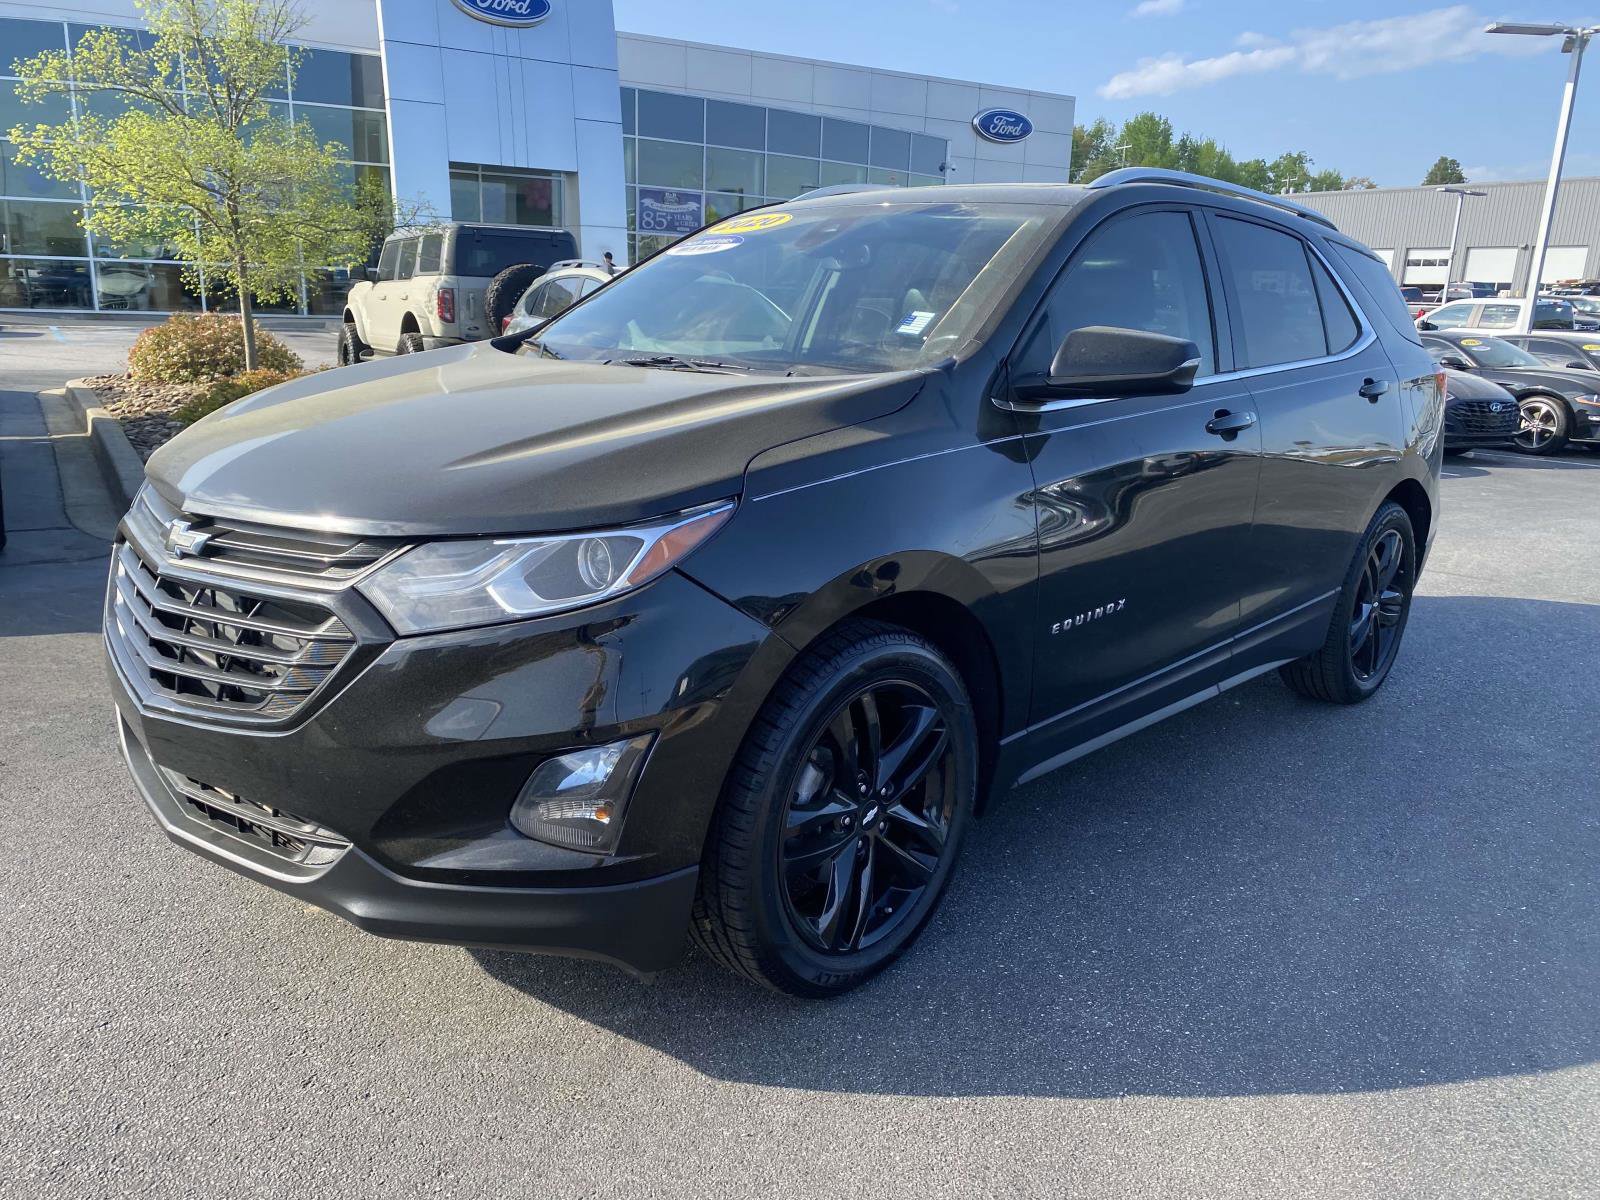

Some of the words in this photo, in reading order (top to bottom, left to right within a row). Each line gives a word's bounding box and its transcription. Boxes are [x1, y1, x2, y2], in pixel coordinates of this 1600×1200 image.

[477, 0, 531, 14] ord
[990, 115, 1023, 136] Ford
[1051, 598, 1126, 635] EQUINOX
